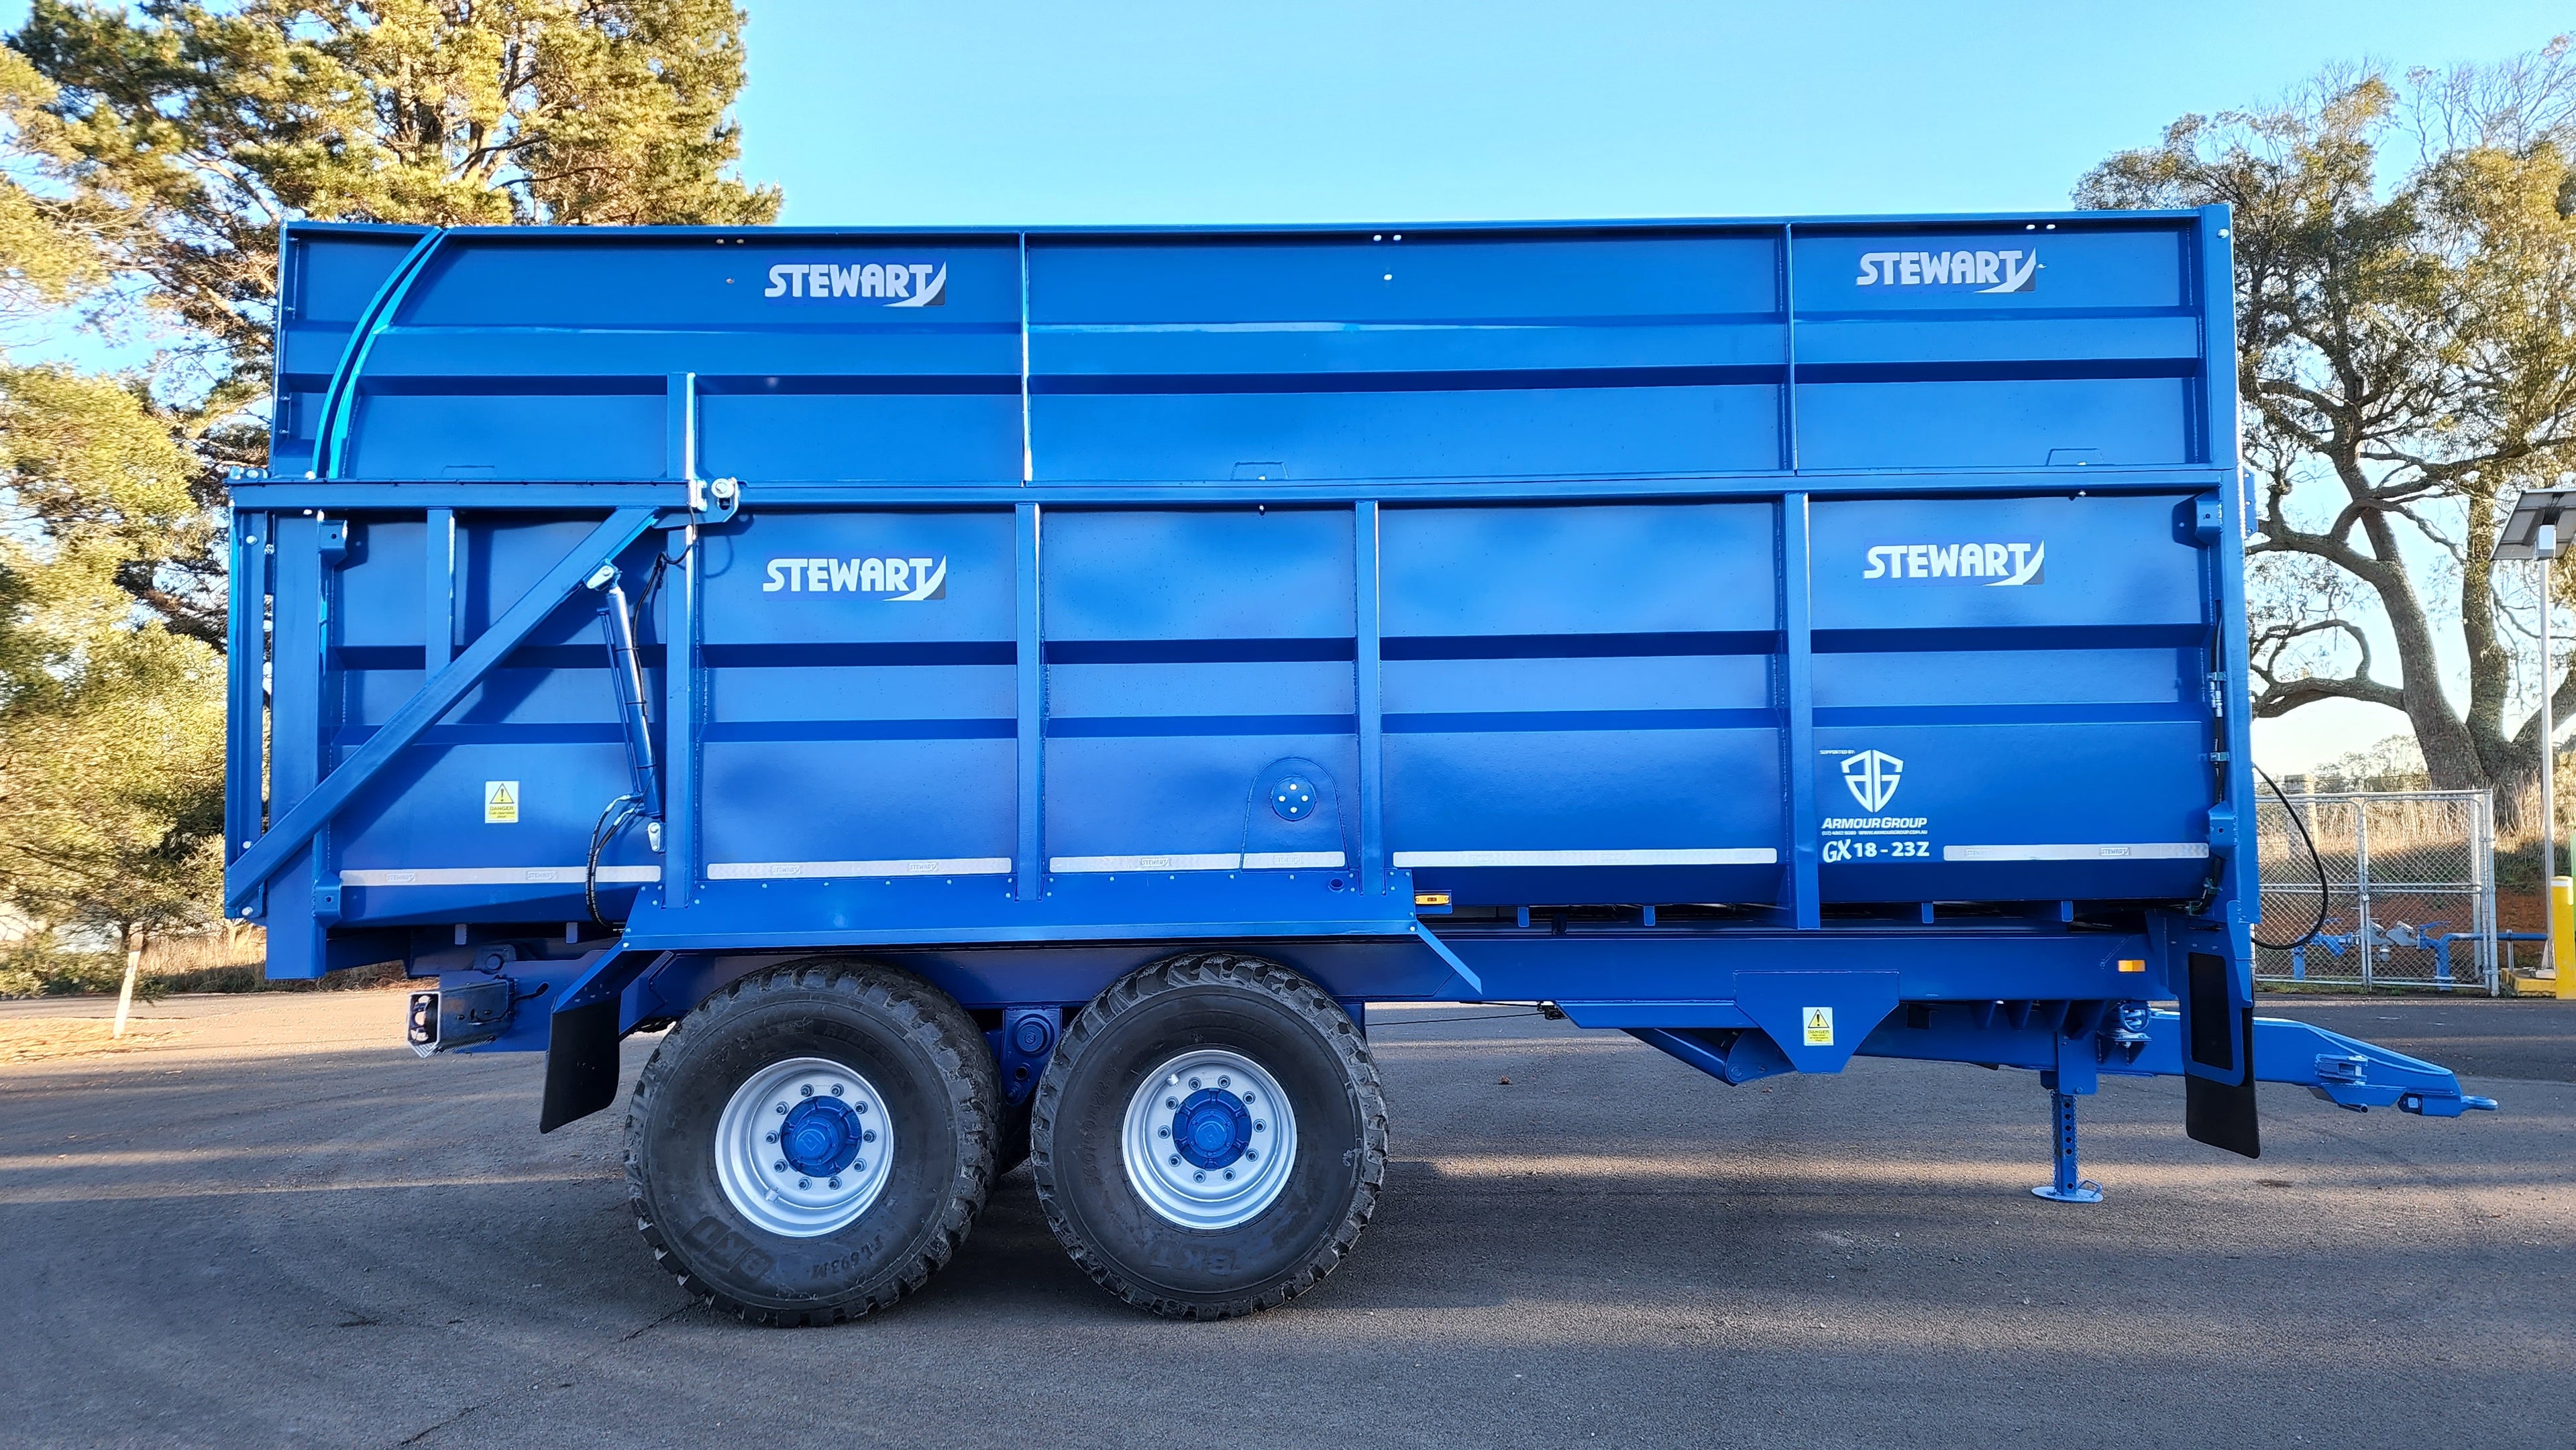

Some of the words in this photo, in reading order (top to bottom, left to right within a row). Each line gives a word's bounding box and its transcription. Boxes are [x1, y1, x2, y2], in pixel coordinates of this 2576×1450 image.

[764, 262, 946, 306] STEWART
[1856, 247, 2036, 292] STEWART
[763, 555, 946, 601] STEWART
[1863, 540, 2045, 586] STEWART
[690, 1221, 770, 1280] BKT
